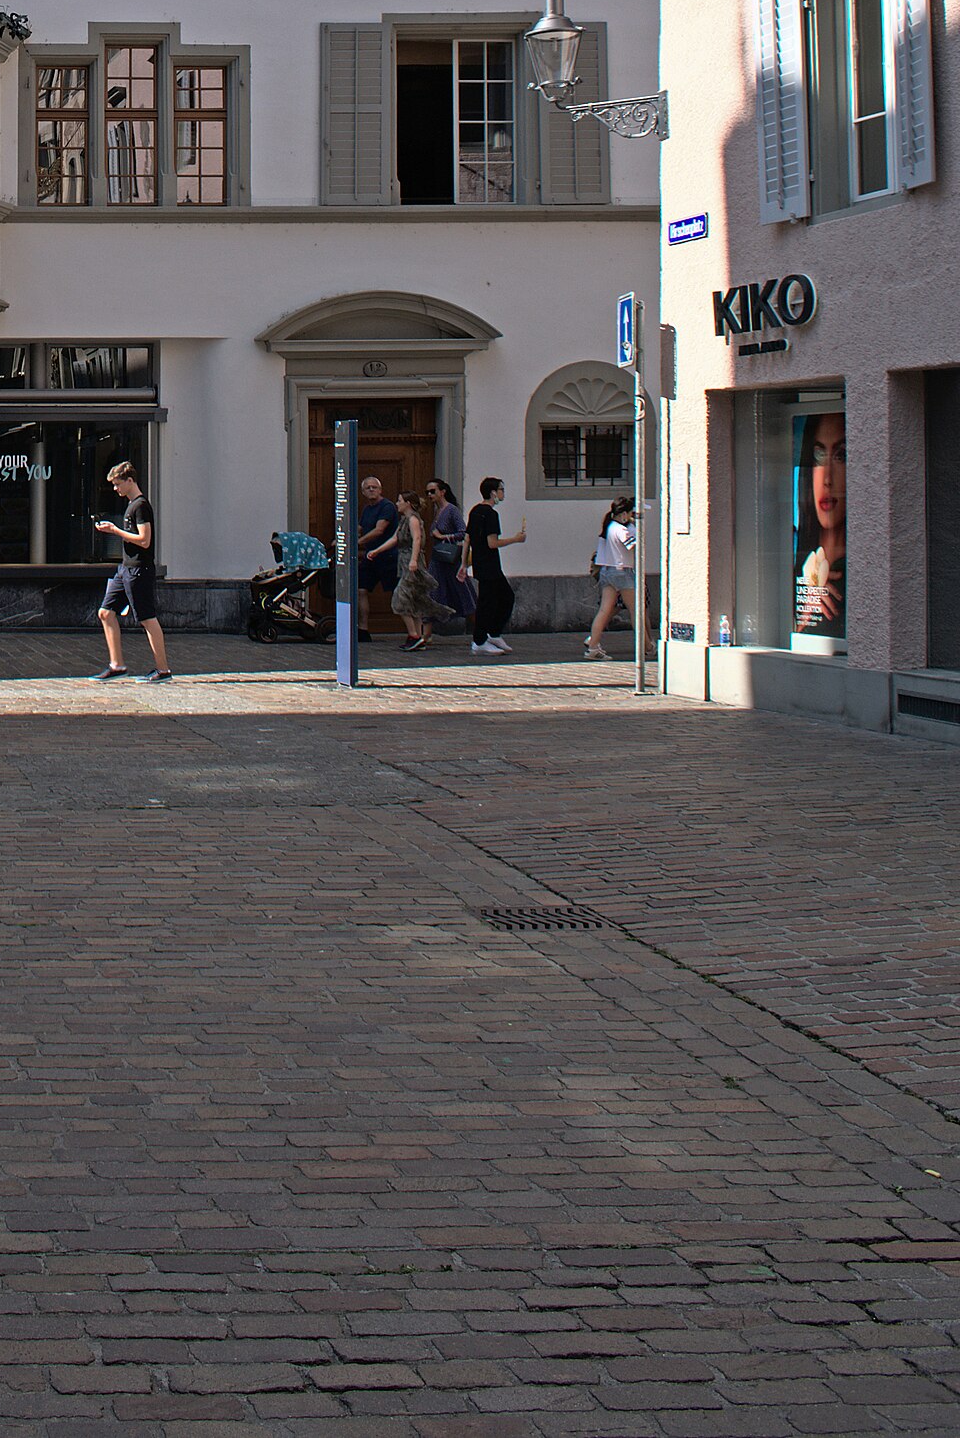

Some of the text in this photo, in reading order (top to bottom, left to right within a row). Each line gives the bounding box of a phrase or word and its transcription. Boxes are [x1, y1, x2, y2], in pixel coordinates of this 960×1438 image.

[712, 273, 816, 337] KIKO
[26, 464, 52, 481] YOU
[796, 585, 829, 596] UNEXPECTED
[796, 594, 822, 605] PARADISE
